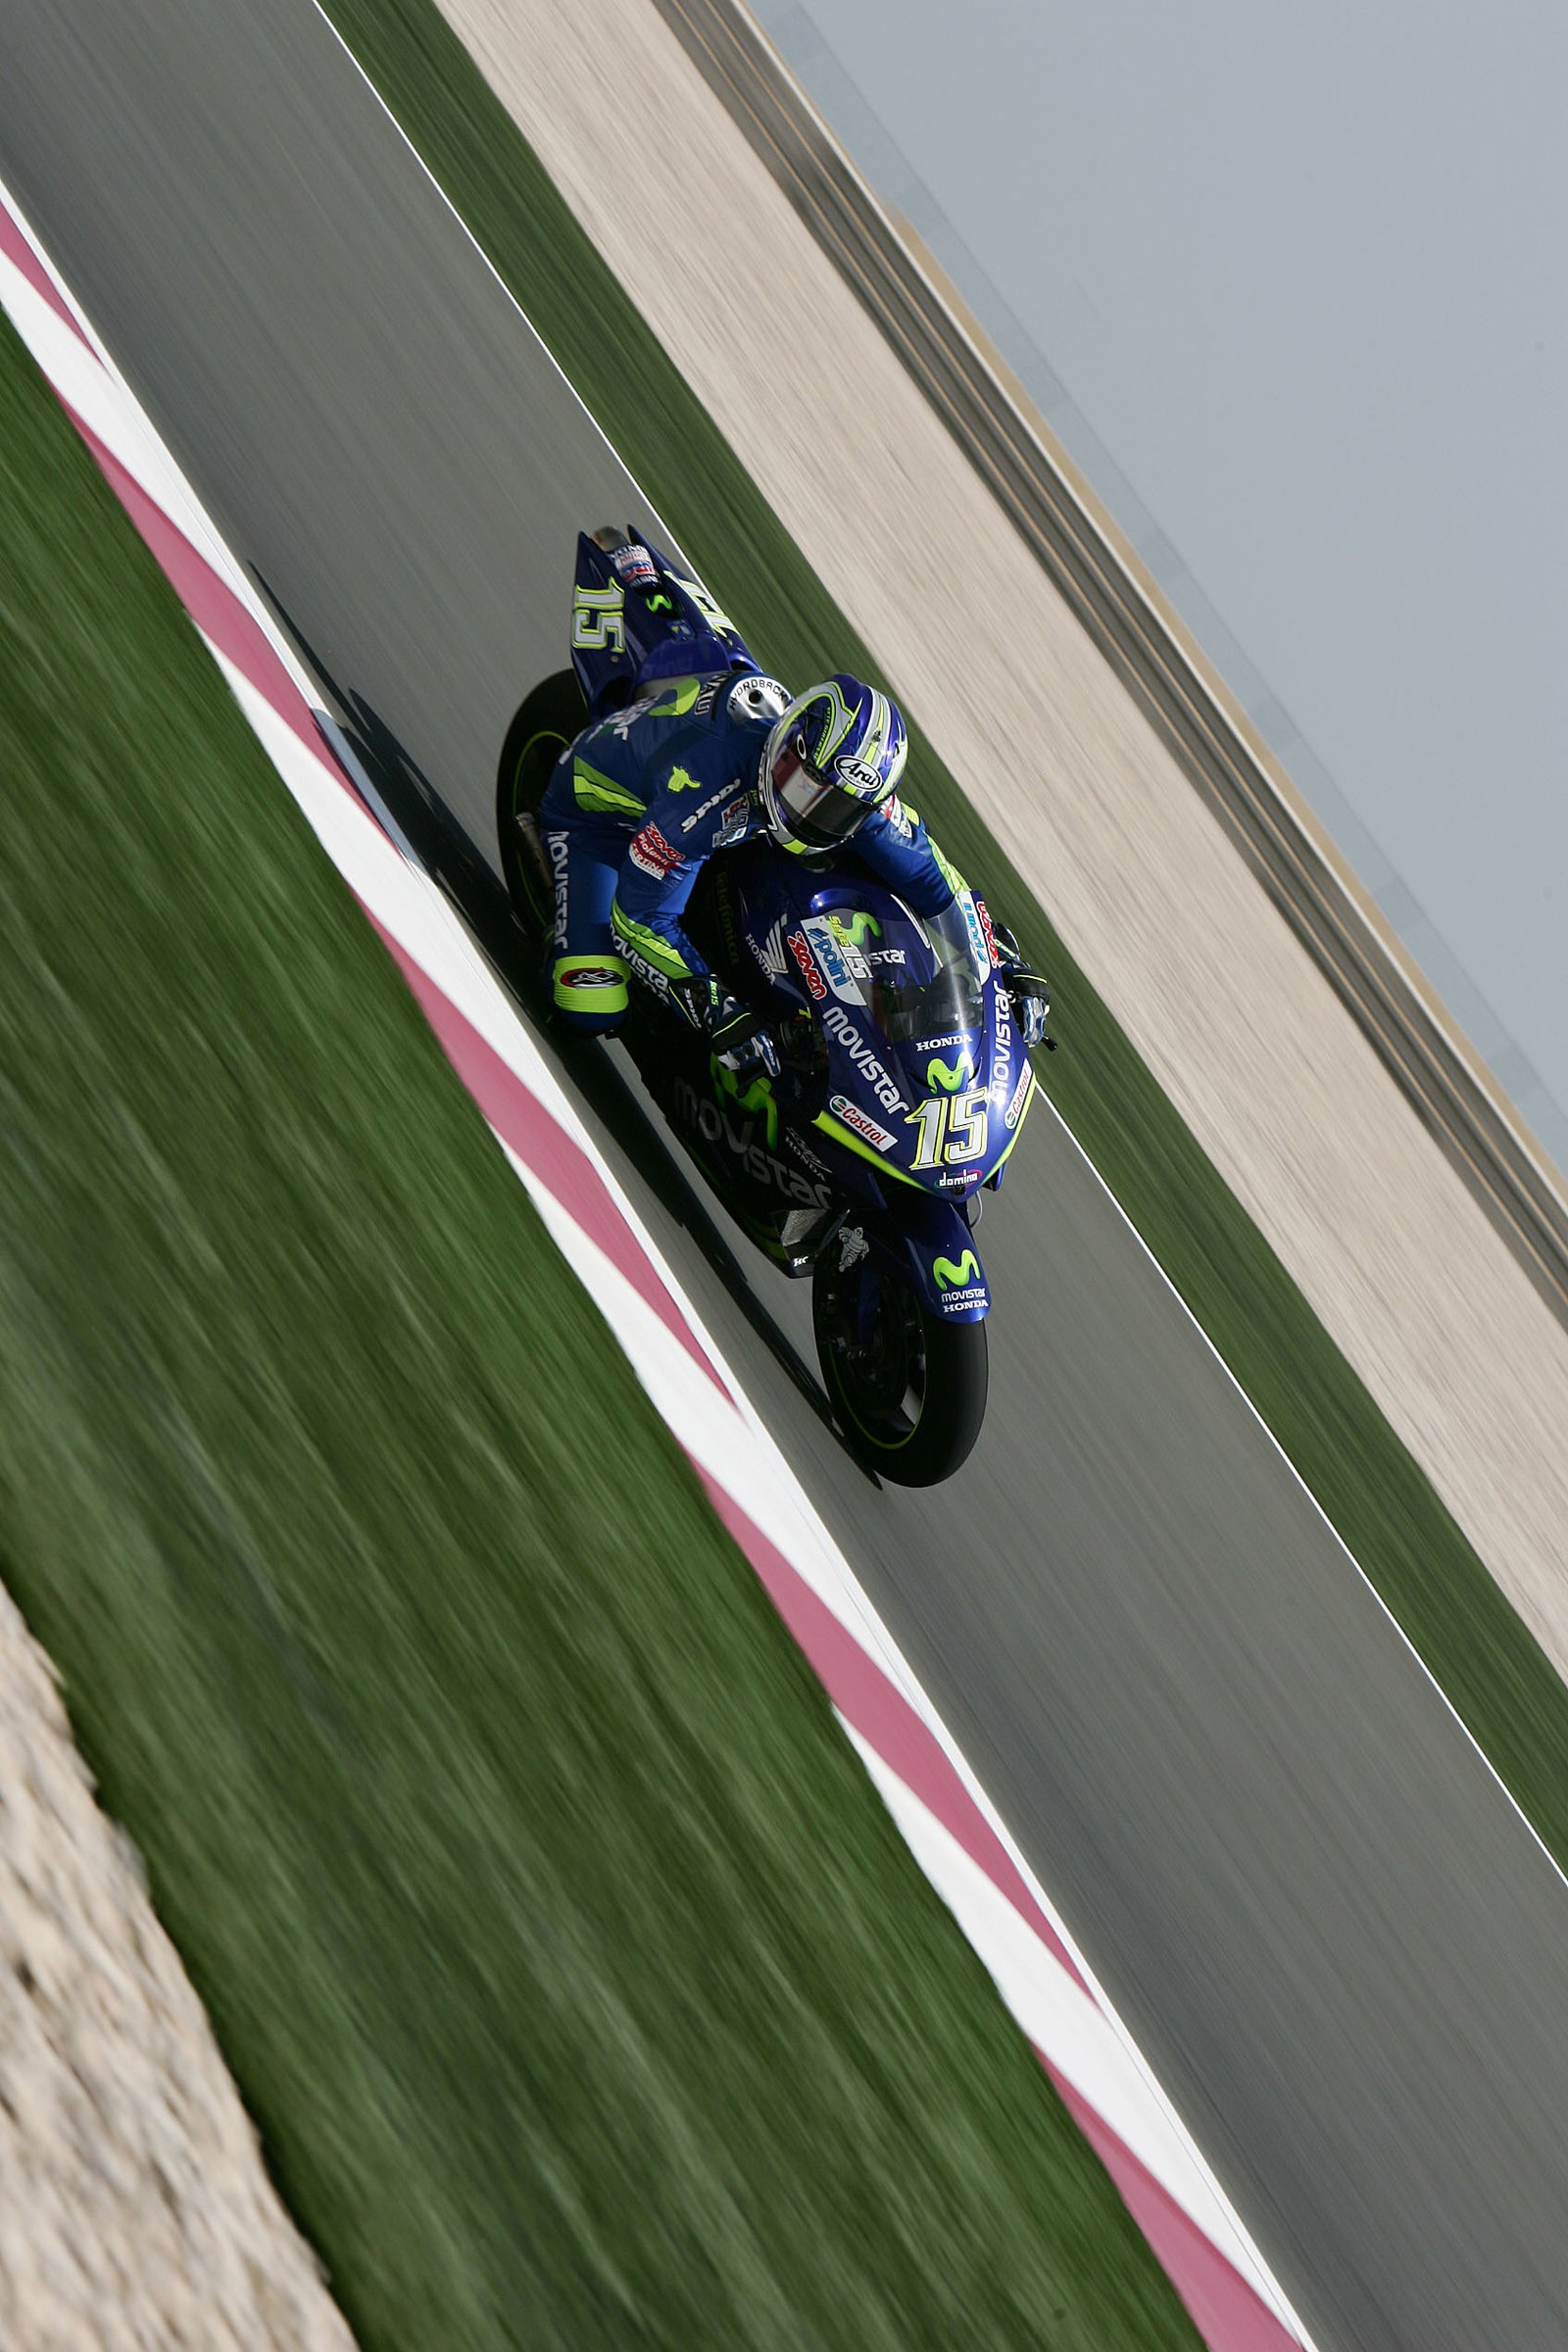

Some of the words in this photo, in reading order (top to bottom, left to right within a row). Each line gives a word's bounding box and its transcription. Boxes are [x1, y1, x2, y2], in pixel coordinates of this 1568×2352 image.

[572, 576, 625, 653] 15
[729, 679, 789, 710] HYDROBACK
[840, 762, 877, 785] Arai
[745, 933, 776, 986] HONDA
[814, 939, 849, 987] polini
[821, 1005, 910, 1115] movistar
[915, 1034, 973, 1052] HONDA
[842, 1106, 888, 1146] Castrol
[904, 1086, 989, 1171] 15
[939, 1170, 978, 1187] domino
[941, 1288, 986, 1302] movistar
[943, 1299, 989, 1313] HONDA
